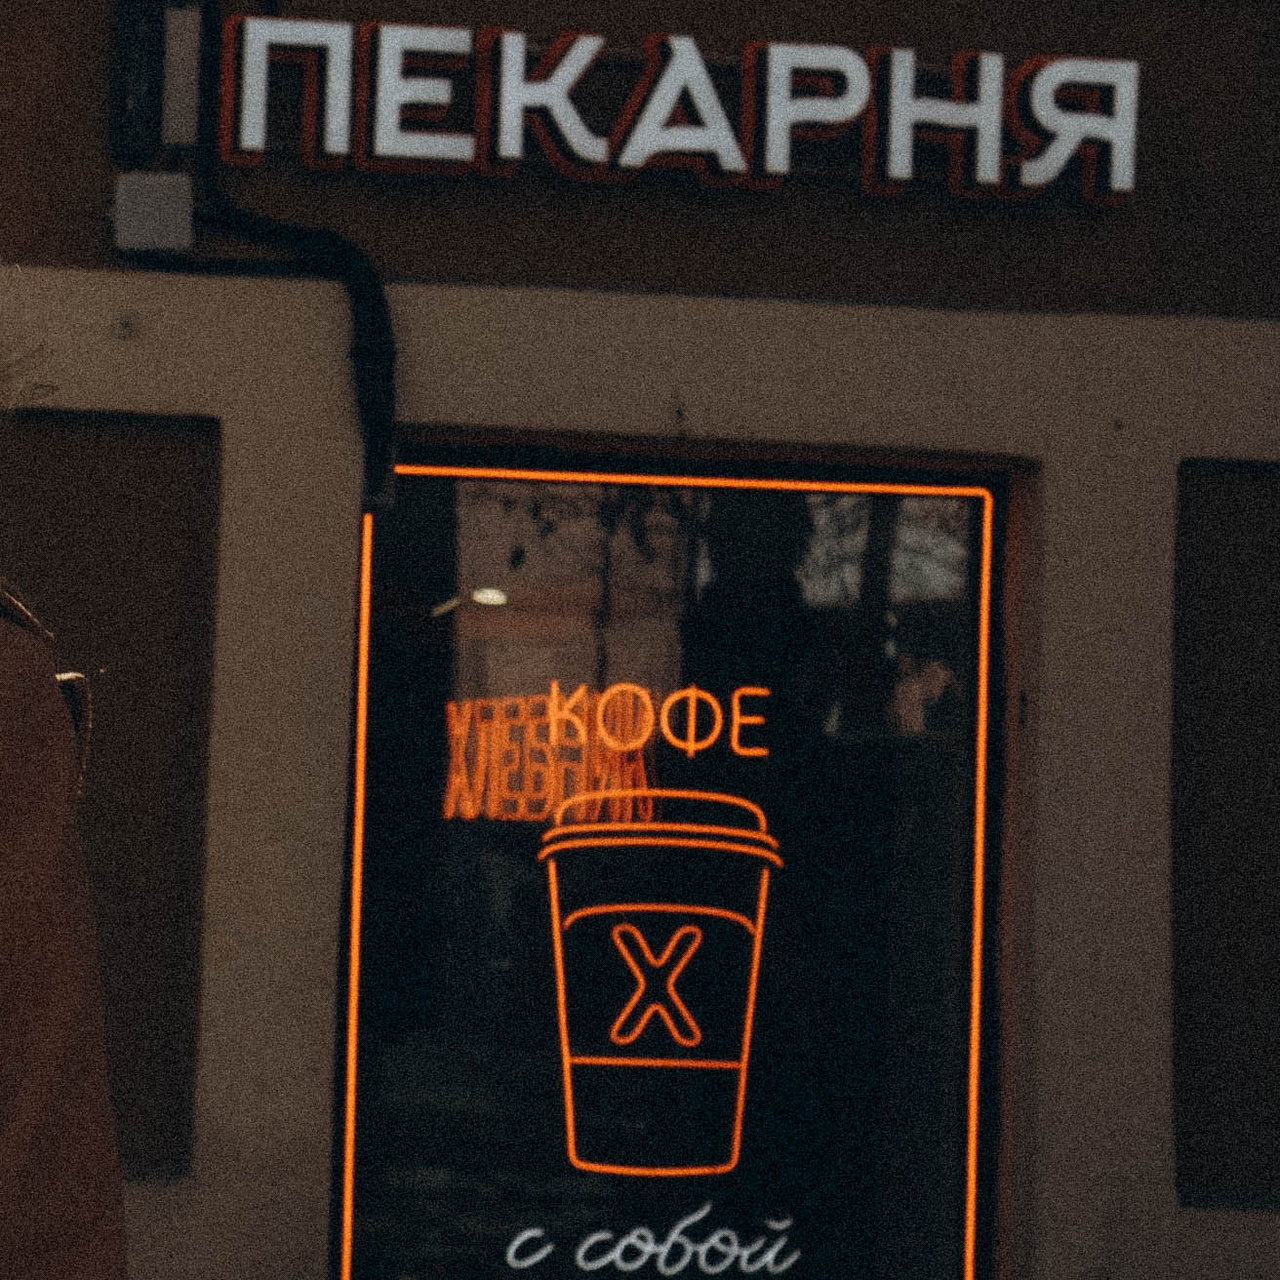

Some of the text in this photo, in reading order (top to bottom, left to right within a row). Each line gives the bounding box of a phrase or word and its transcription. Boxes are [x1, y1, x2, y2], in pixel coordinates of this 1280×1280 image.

[237, 16, 1142, 194] ПЕКАРНЯ
[548, 677, 772, 760] КОФЕ
[505, 1199, 802, 1277] с собой
